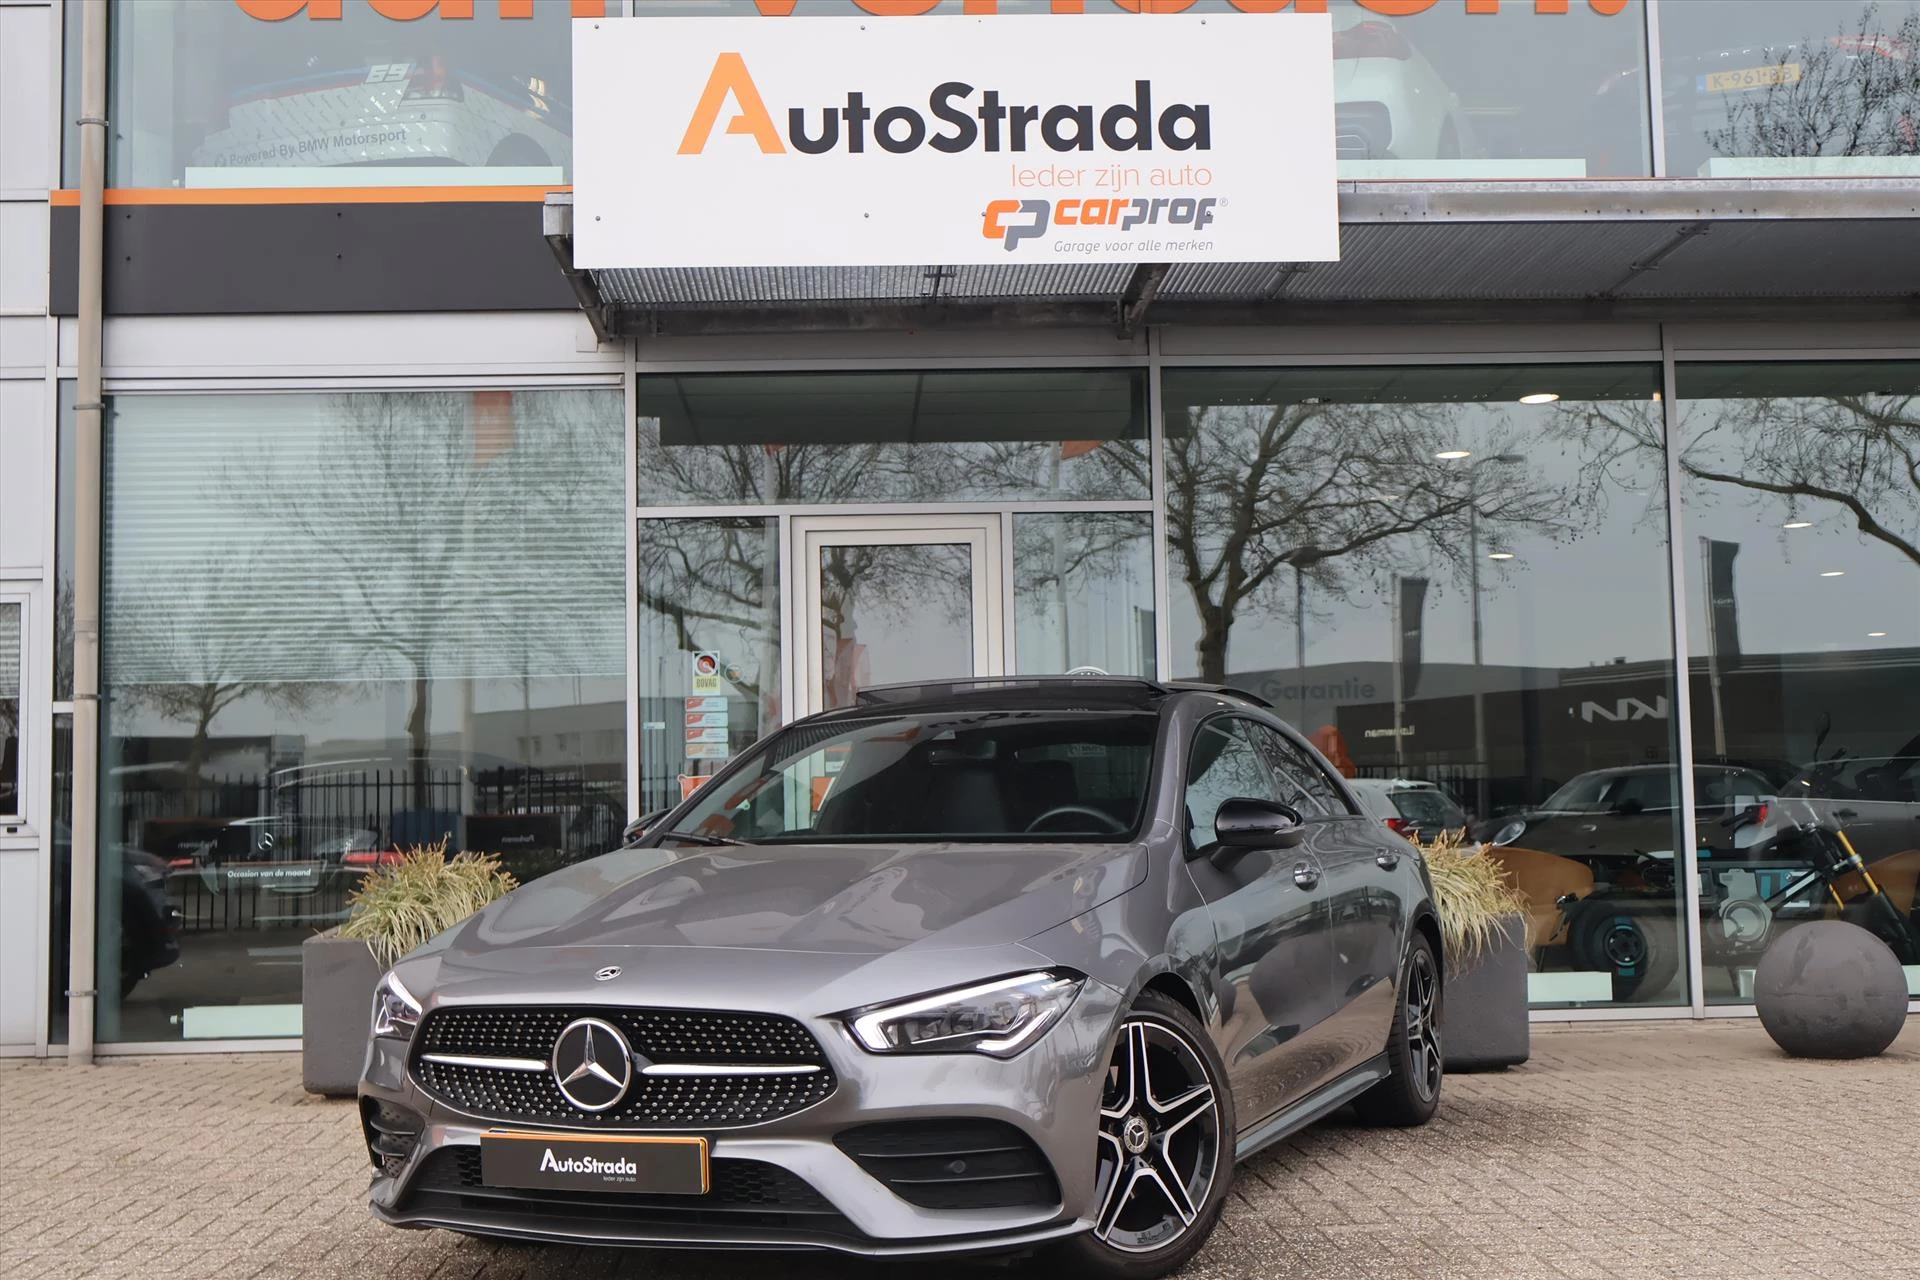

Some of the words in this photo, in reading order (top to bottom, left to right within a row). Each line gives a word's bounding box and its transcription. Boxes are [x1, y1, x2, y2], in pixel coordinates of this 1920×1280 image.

[365, 63, 410, 83] 69
[676, 52, 1211, 154] AutoStrada
[229, 145, 276, 166] Powered
[279, 143, 295, 158] By
[299, 137, 330, 153] BMW
[333, 128, 408, 147] Motorsport
[1012, 164, 1087, 187] Ieder
[1095, 164, 1140, 192] zijn
[1150, 164, 1212, 186] auto
[1053, 198, 1217, 231] carprof
[1054, 240, 1101, 254] Garage
[1105, 242, 1135, 252] voor
[1138, 240, 1162, 251] alle
[1165, 239, 1214, 251] merken
[1260, 677, 1376, 700] Garantie
[227, 869, 259, 878] Occasion
[275, 868, 285, 877] de
[286, 868, 312, 877] maand
[540, 1148, 637, 1174] AutoStrada
